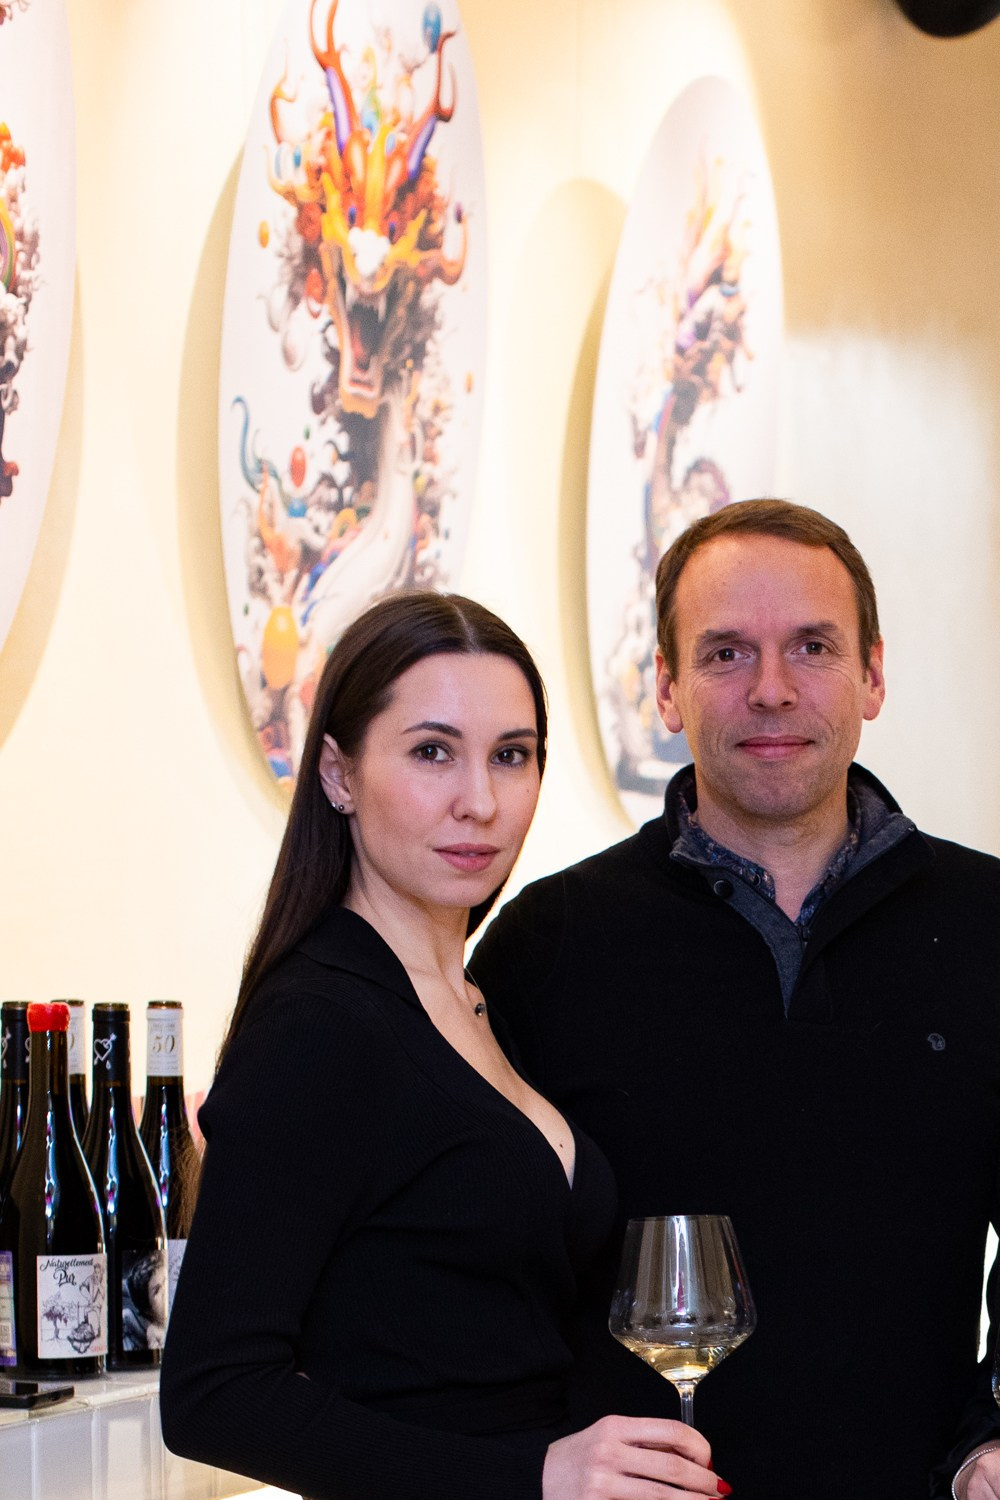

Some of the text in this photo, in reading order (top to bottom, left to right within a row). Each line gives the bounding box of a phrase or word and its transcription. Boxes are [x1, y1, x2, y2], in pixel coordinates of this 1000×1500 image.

[152, 1031, 175, 1054] 50
[40, 1259, 94, 1272] Naturellement
[53, 1267, 77, 1288] Pur
